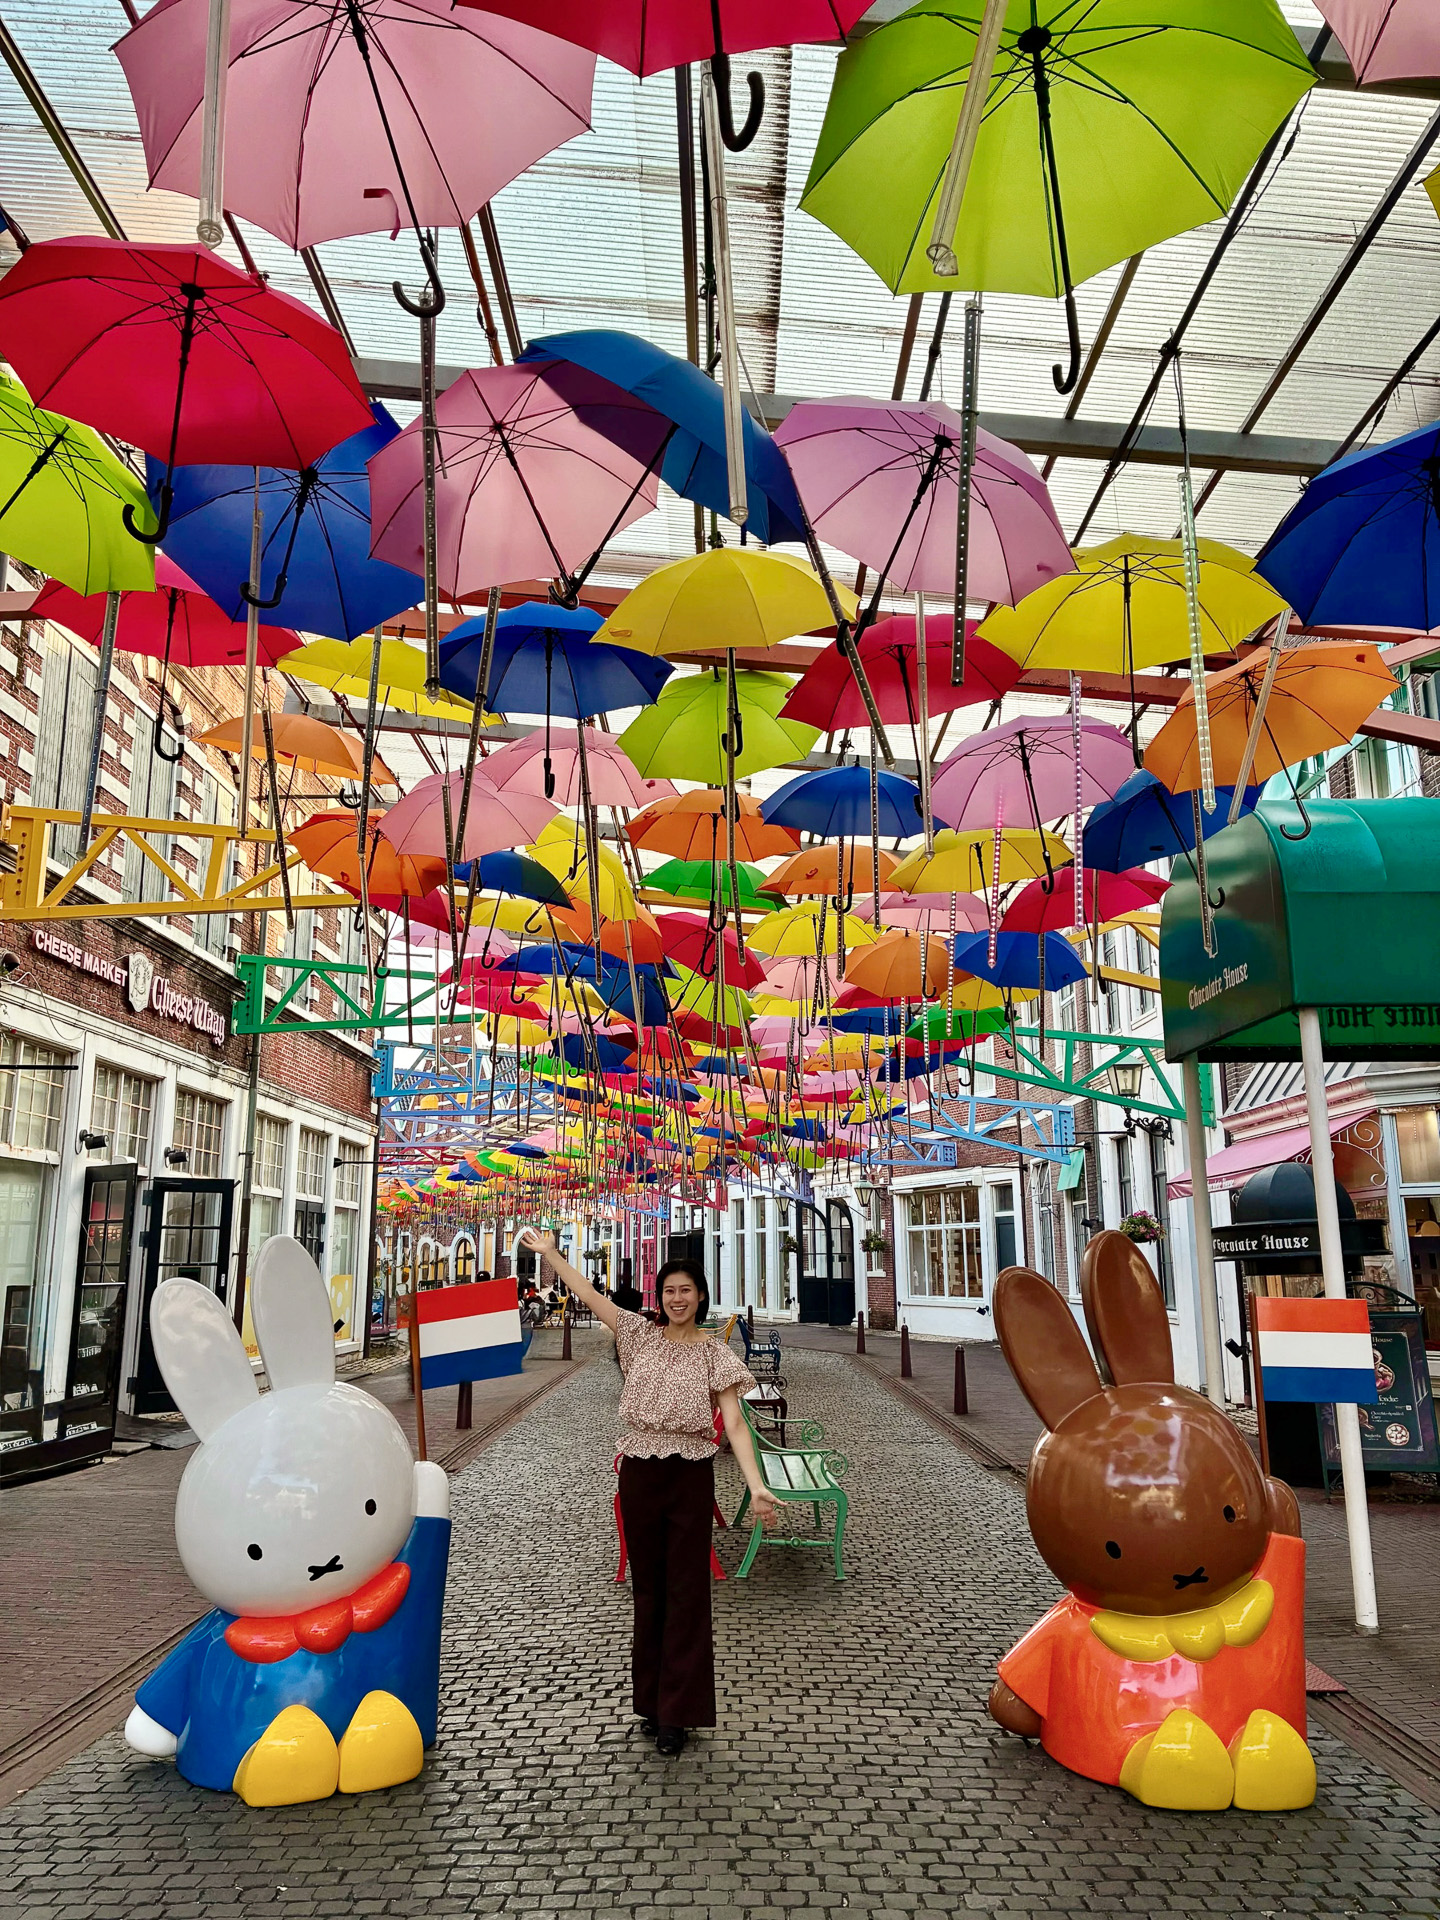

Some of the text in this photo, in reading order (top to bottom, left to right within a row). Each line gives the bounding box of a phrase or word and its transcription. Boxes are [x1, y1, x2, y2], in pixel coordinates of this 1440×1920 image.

[33, 929, 84, 969] CHEESE
[83, 951, 128, 987] MARKET
[152, 975, 226, 1046] Cheese Waag
[1188, 963, 1248, 1010] Chocolate House
[1261, 1234, 1309, 1249] House
